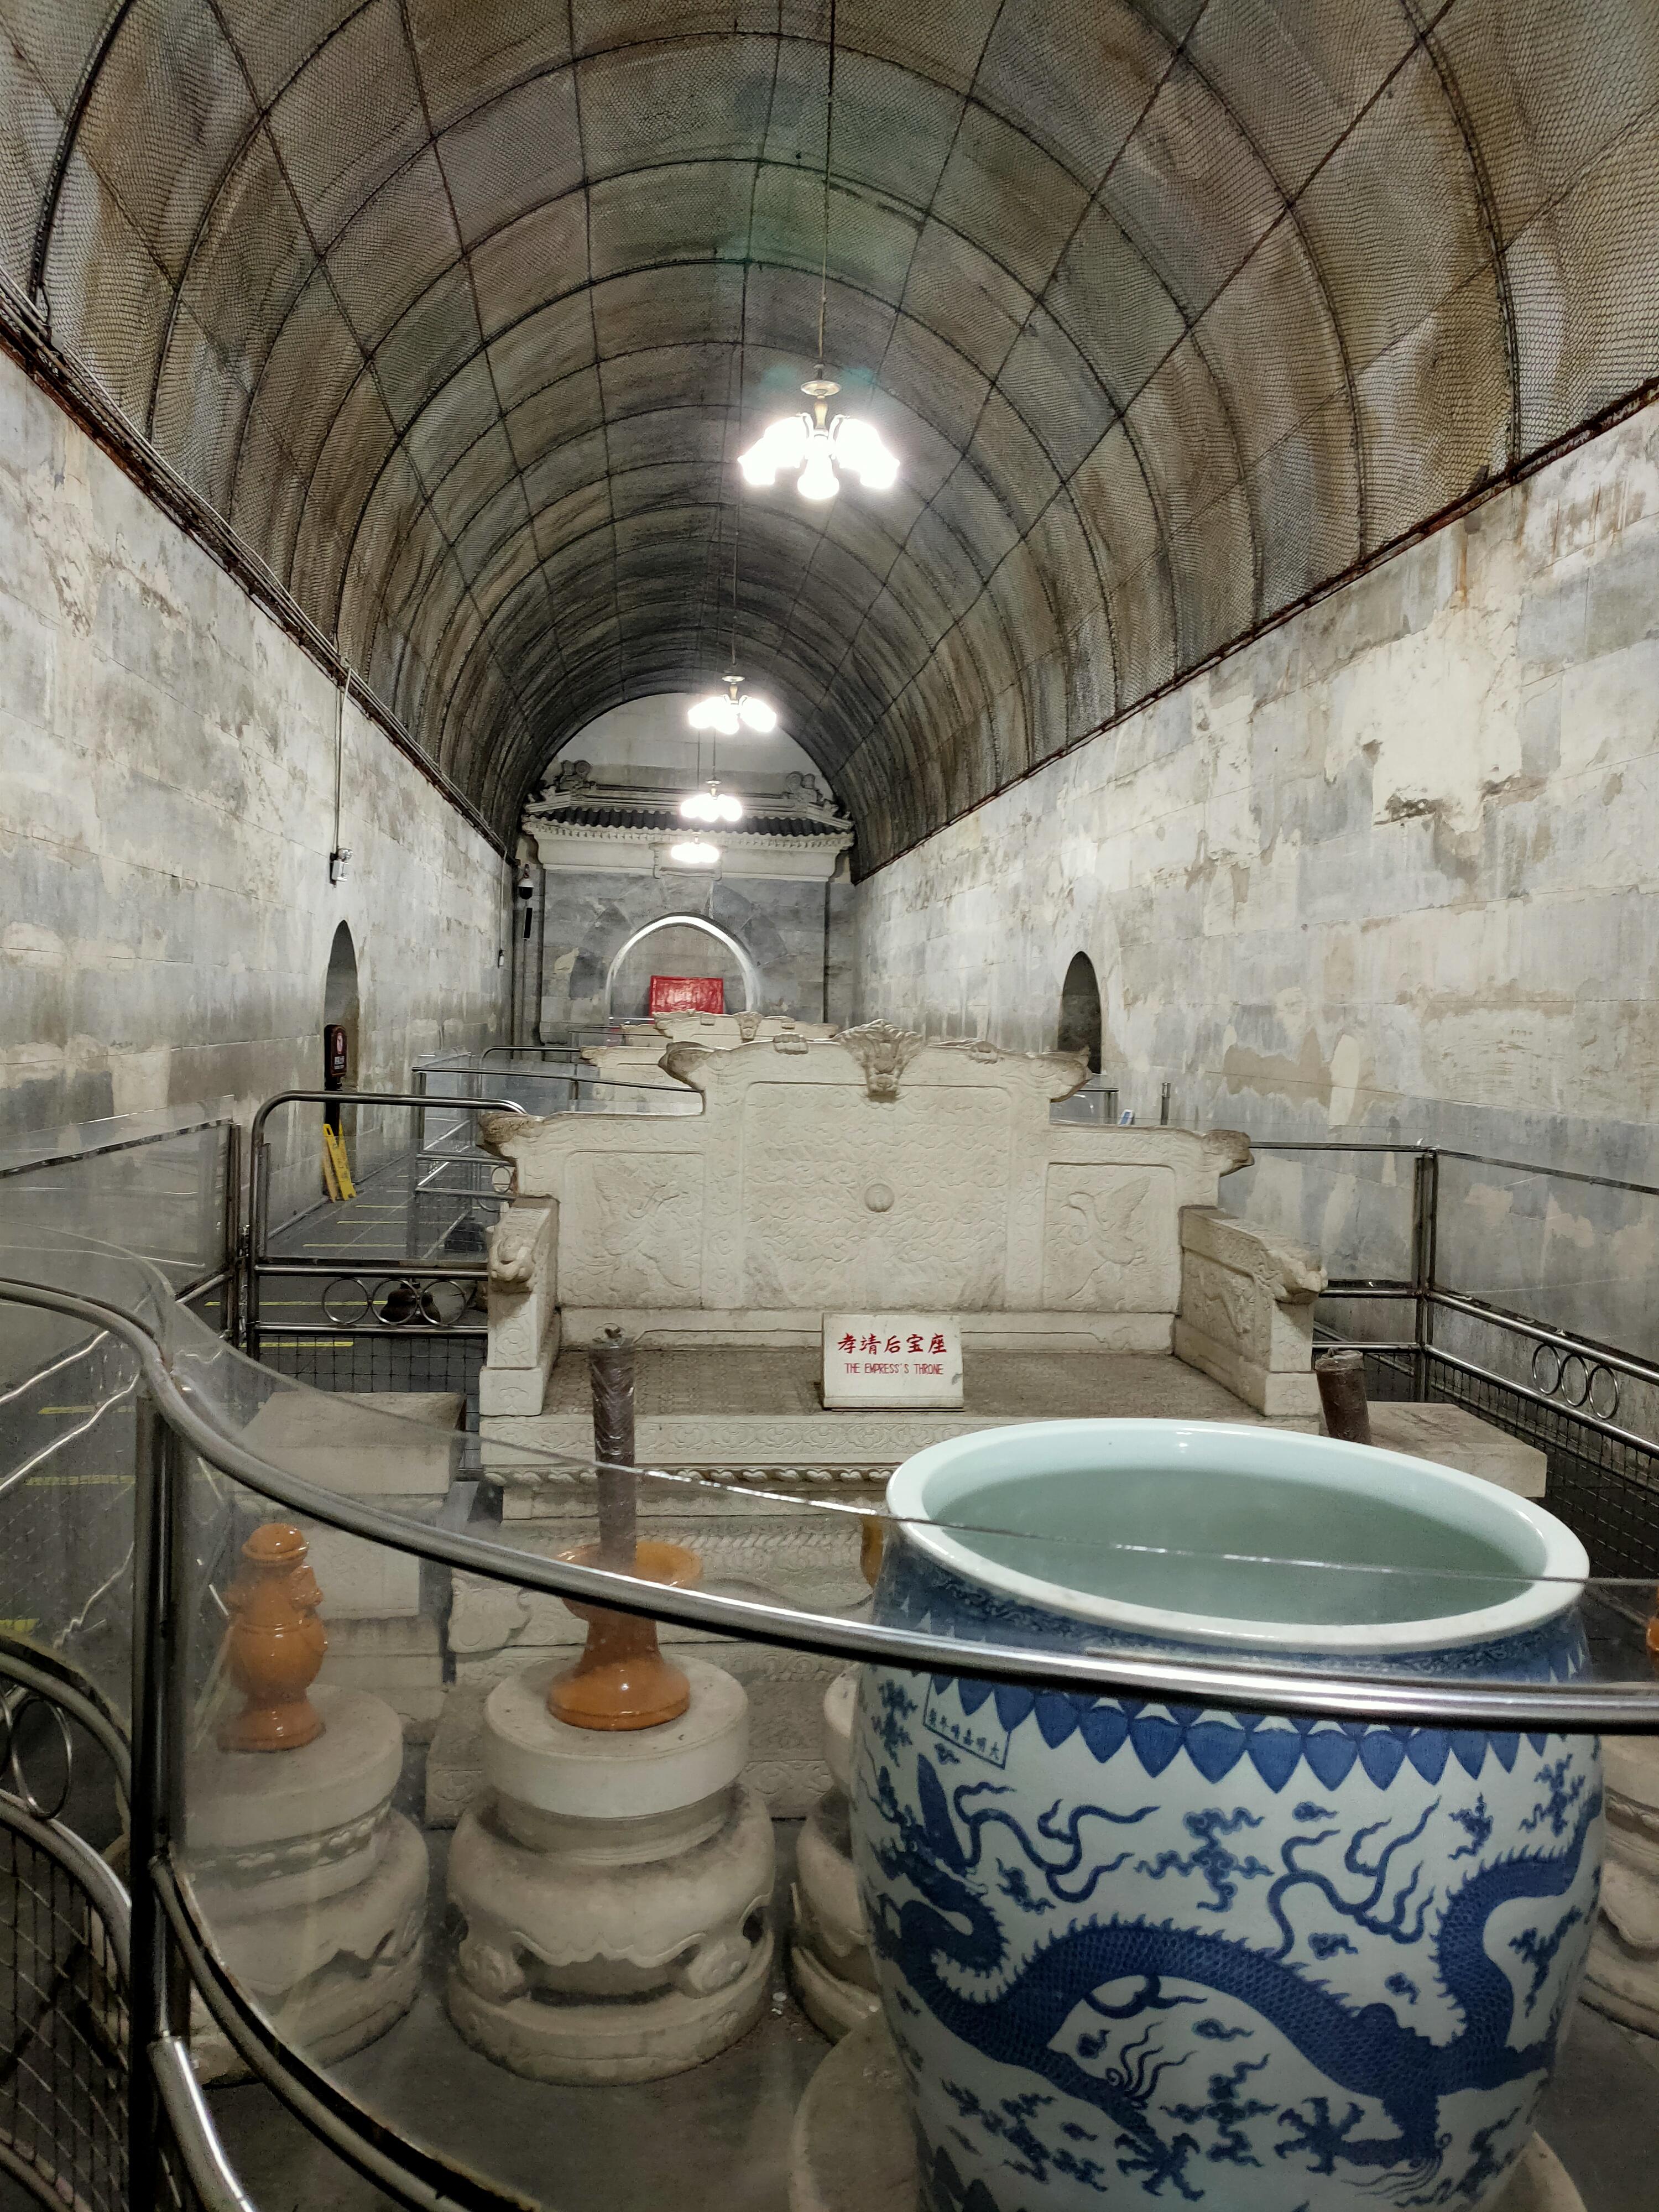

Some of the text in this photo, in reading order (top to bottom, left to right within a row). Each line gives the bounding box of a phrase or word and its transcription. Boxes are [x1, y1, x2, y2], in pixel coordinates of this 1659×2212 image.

[837, 1333, 947, 1355] 孝靖后宝座
[844, 1363, 944, 1375] THE EMPRESS'S THRONE
